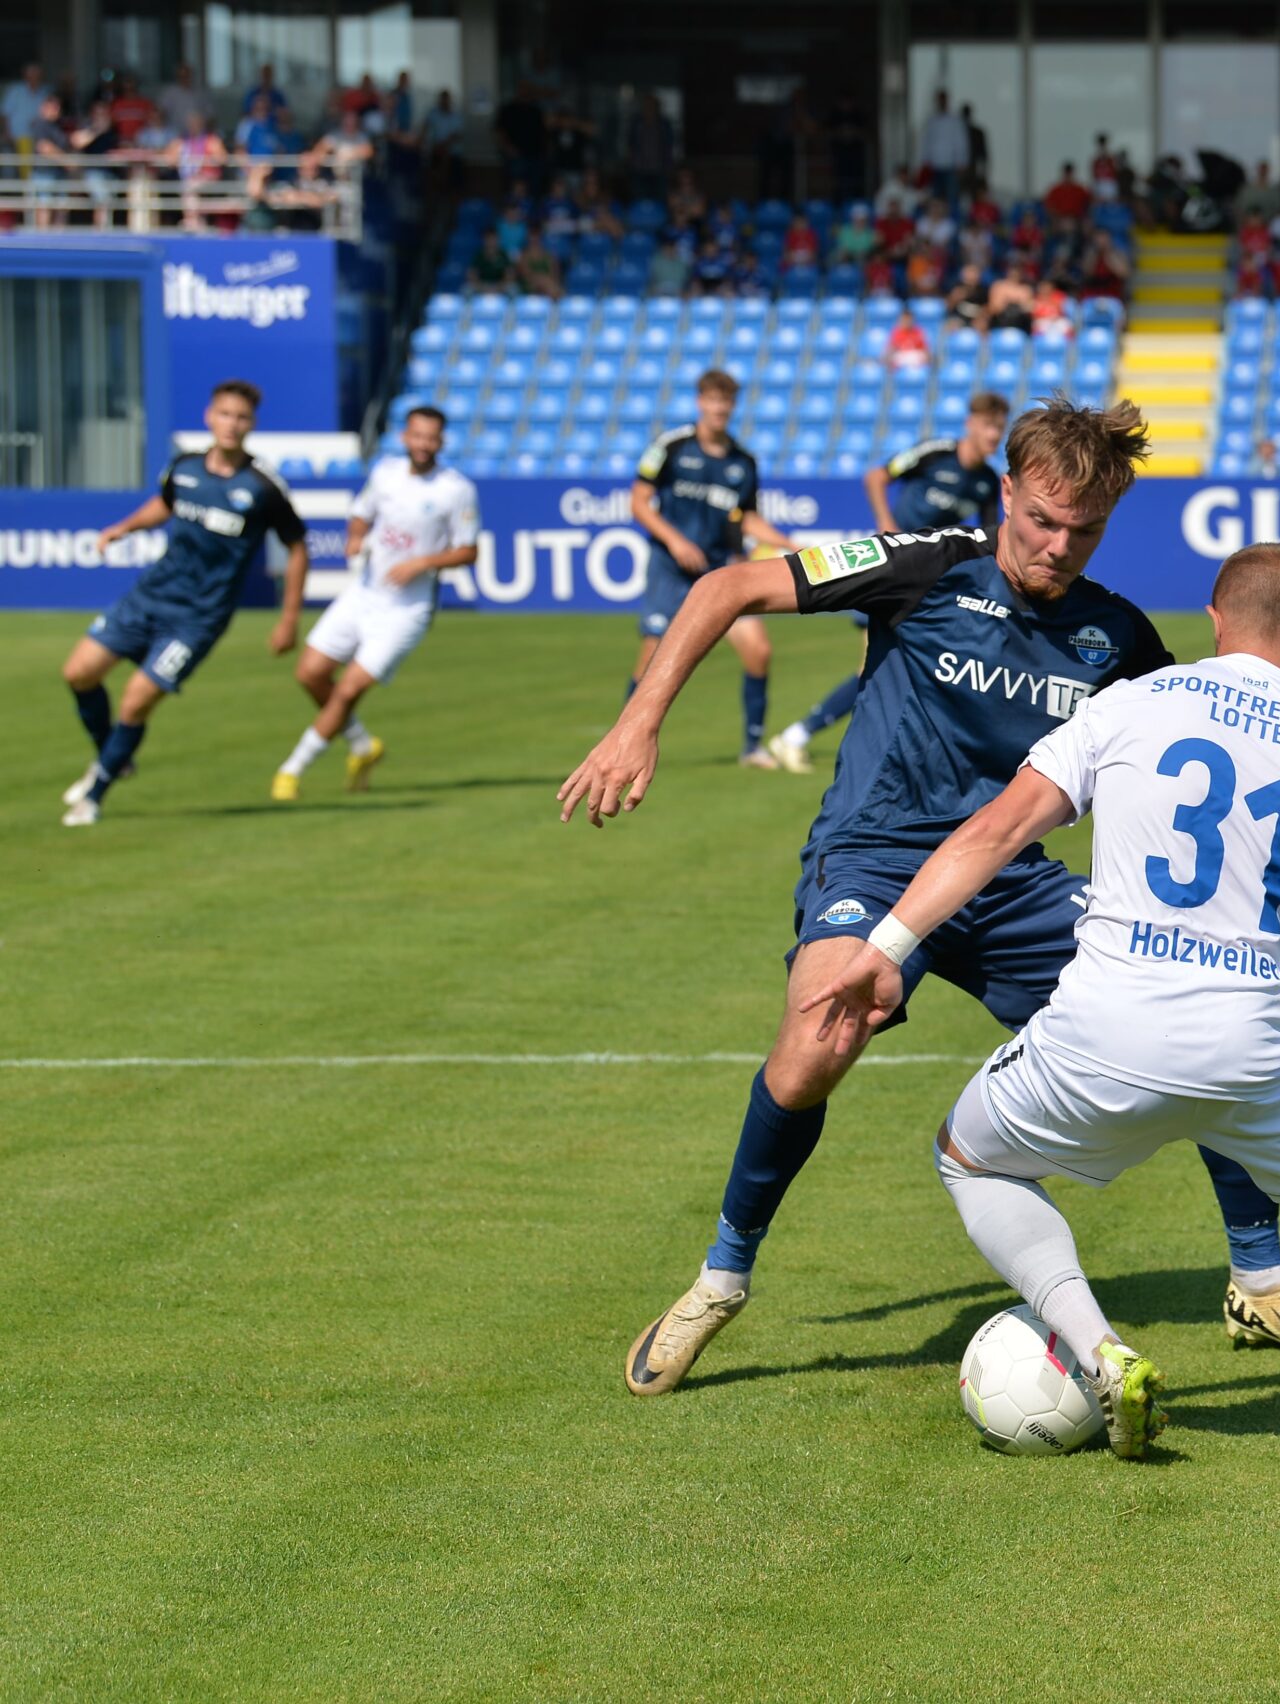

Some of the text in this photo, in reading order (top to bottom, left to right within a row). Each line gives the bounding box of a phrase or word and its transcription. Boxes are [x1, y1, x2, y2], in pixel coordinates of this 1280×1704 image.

[0, 530, 168, 568] UNGEN
[935, 652, 1096, 718] SAVVYTE
[1129, 920, 1280, 981] Holzweiler
[1025, 1422, 1064, 1450] capelli
